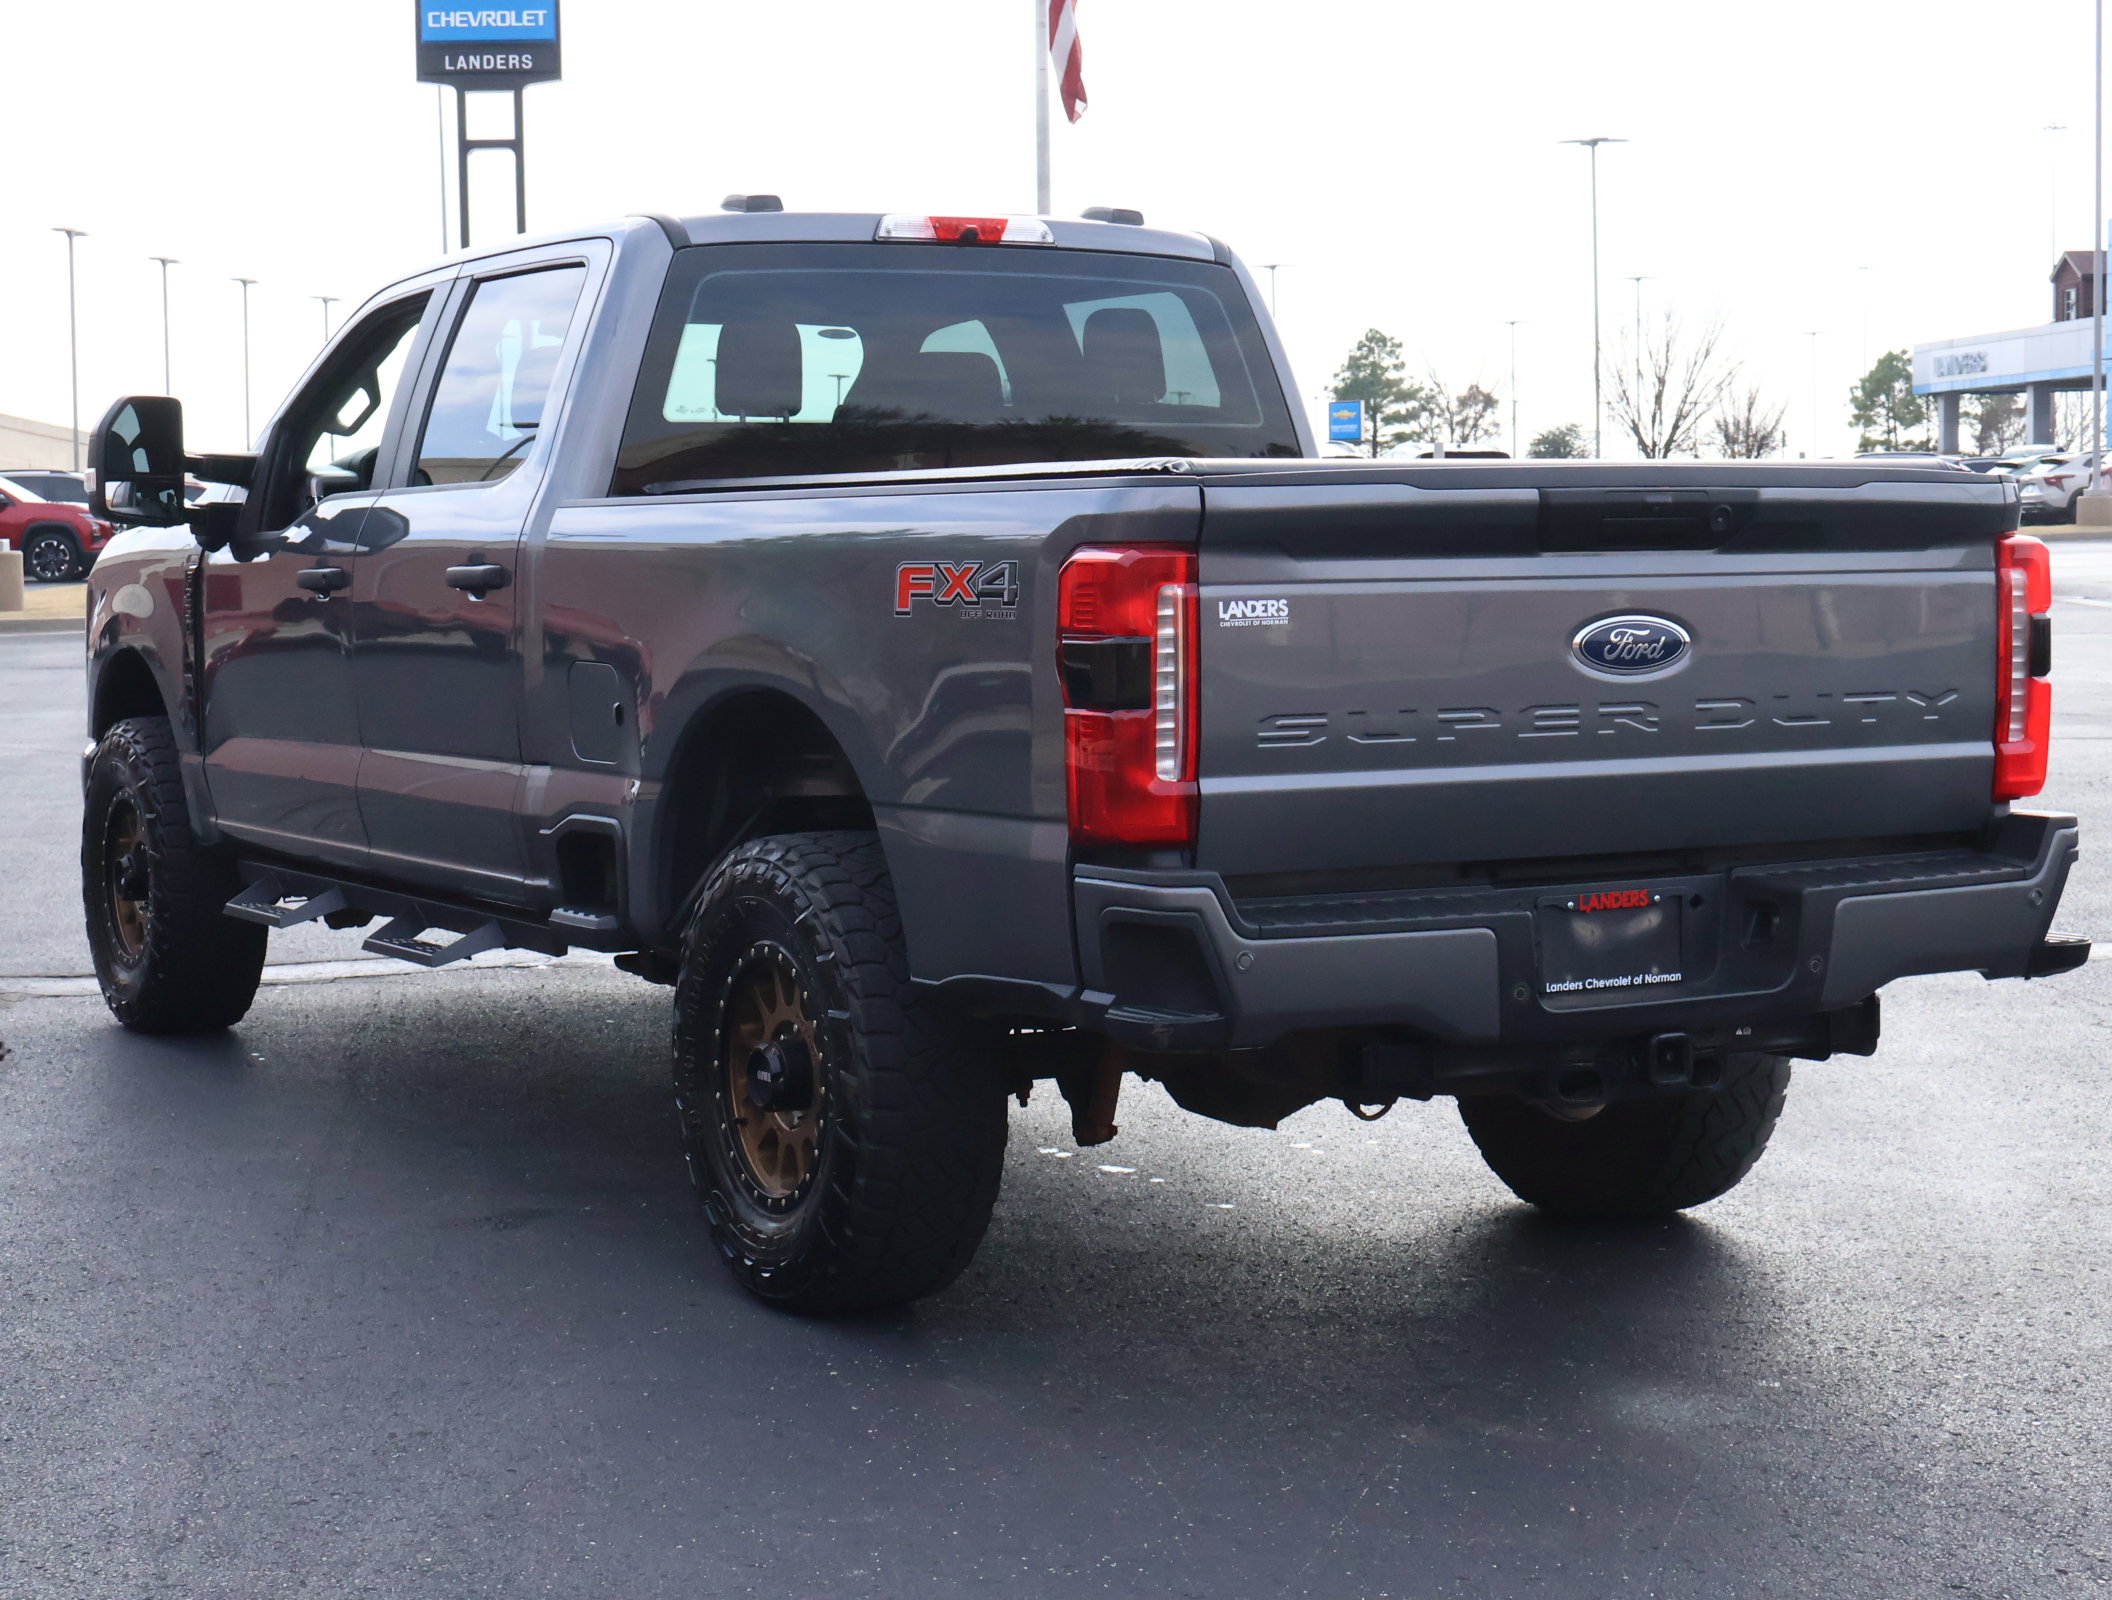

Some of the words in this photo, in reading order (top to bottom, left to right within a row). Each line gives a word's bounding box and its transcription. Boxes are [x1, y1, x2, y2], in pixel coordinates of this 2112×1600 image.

[428, 10, 547, 27] CHEVROLET
[445, 54, 533, 70] LANDERS
[894, 560, 1019, 617] FX4
[960, 609, 982, 619] OFF
[1218, 599, 1289, 620] LANDERS
[1220, 620, 1252, 628] CHEVROLET
[1261, 618, 1289, 626] NORMAN
[1603, 628, 1666, 660] Ford
[1257, 700, 1660, 748] SUPER
[1694, 688, 1959, 730] DUTY
[1578, 889, 1650, 913] LANDERS
[1546, 979, 1583, 993] Landers
[1585, 974, 1632, 989] Chevrolet
[1633, 973, 1644, 985] of
[1644, 972, 1682, 984] Norman
